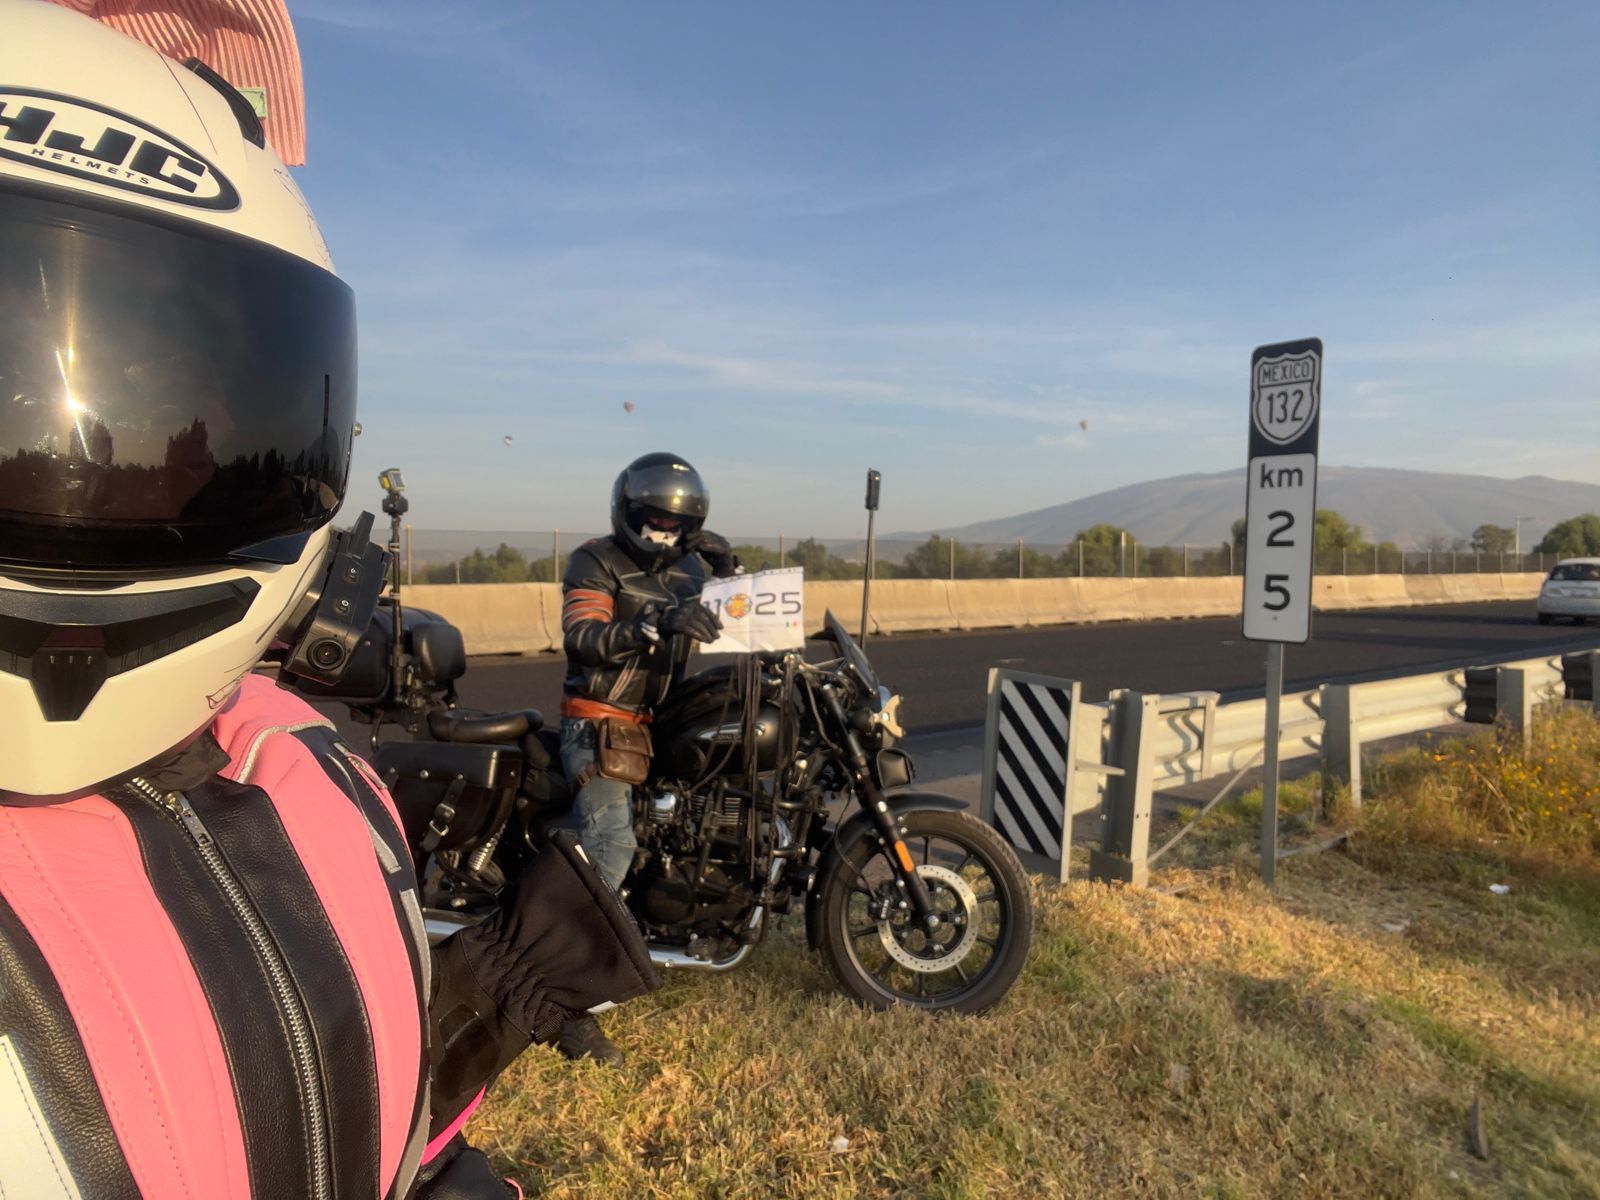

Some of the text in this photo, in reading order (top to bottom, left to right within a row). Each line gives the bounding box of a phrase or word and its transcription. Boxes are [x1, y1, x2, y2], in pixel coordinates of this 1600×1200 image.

[31, 147, 150, 185] HELMETS
[1262, 361, 1310, 383] MEXICO
[1267, 389, 1304, 424] 132
[1260, 463, 1303, 488] km
[1266, 510, 1295, 547] 2
[755, 592, 801, 615] 25
[1263, 574, 1291, 611] 5
